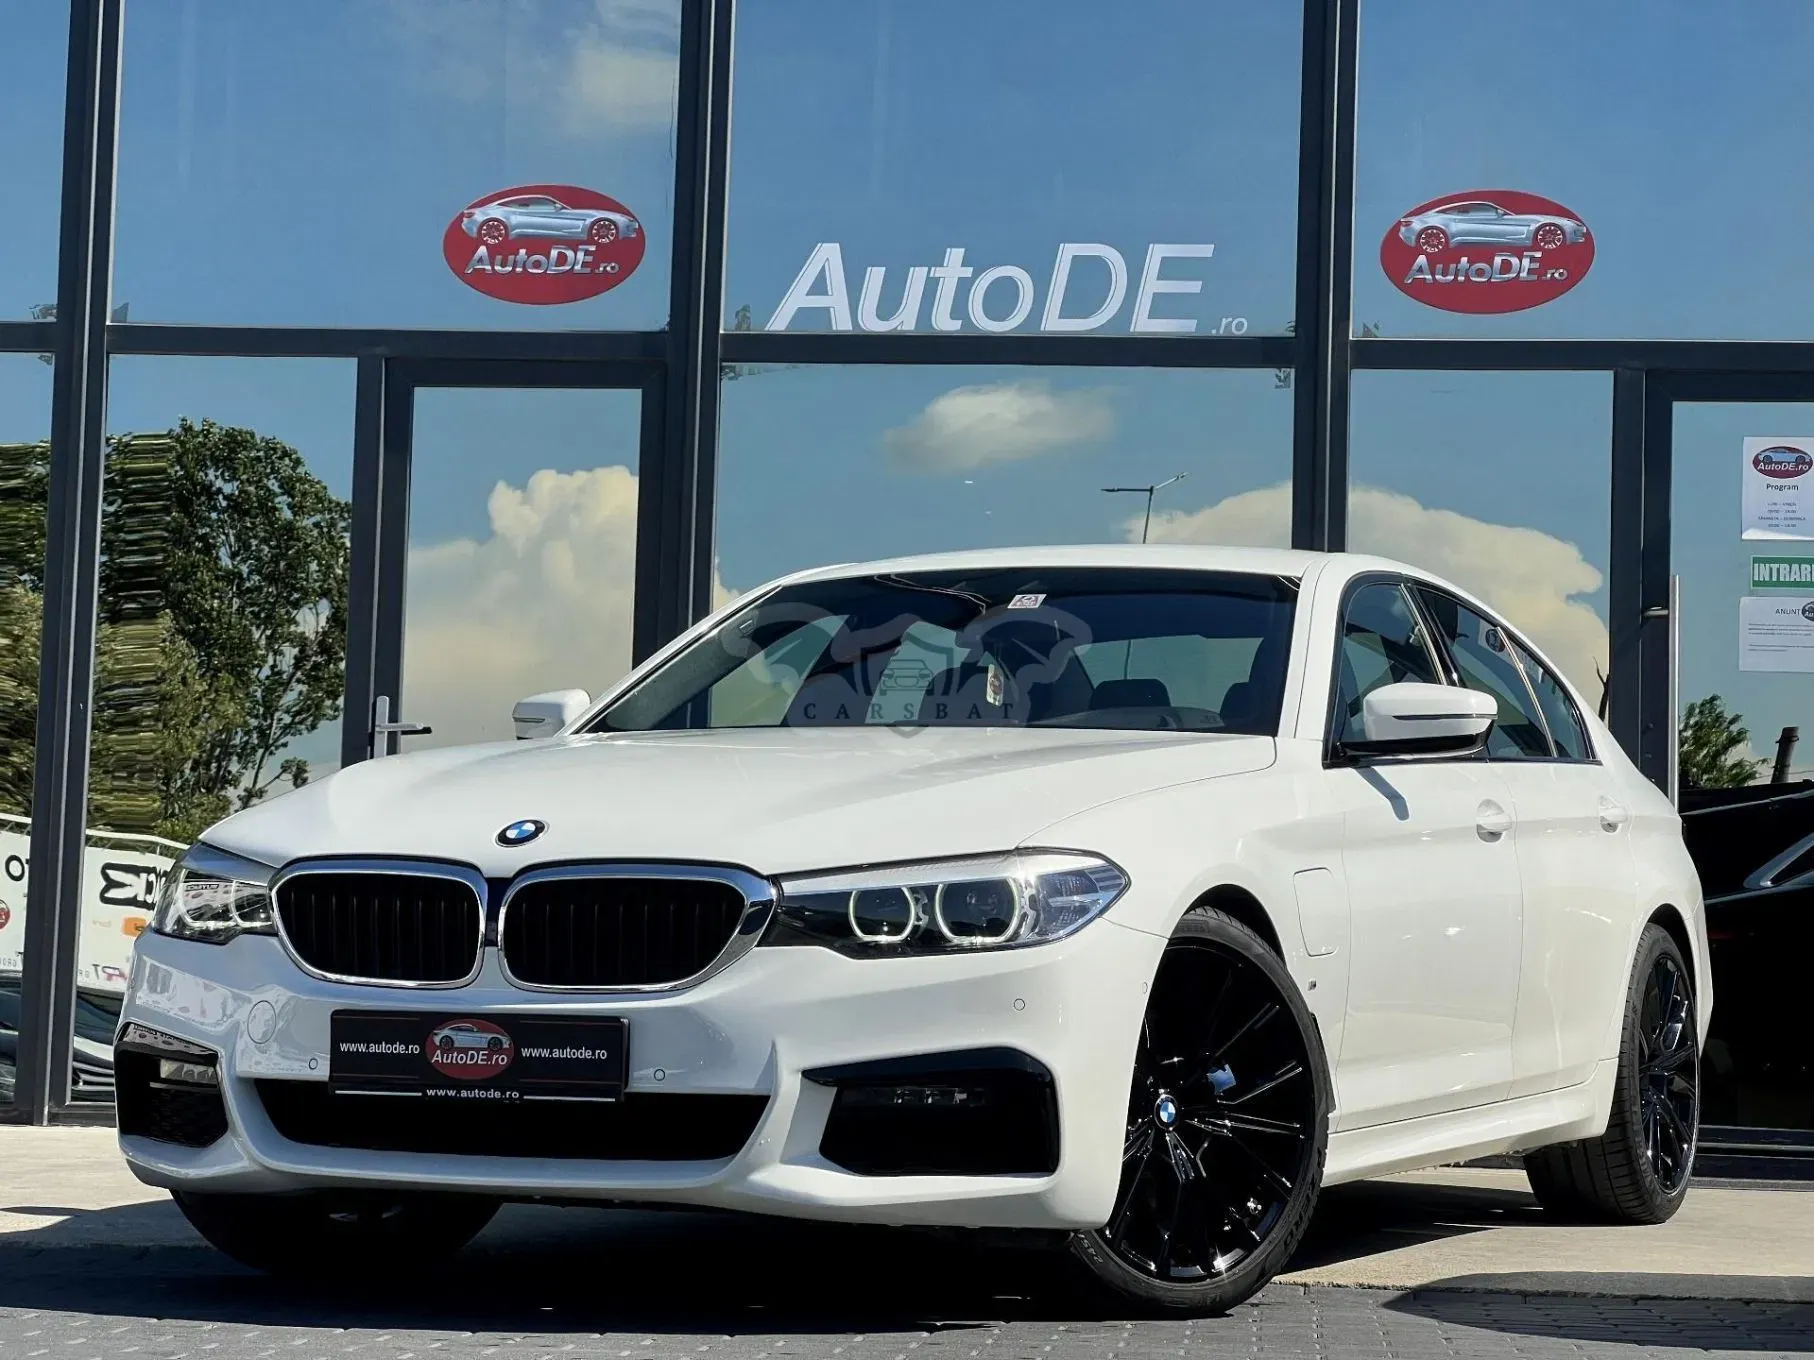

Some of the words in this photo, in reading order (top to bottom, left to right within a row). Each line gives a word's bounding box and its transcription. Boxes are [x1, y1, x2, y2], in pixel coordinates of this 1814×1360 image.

[1757, 462, 1809, 471] AutoDE.ro
[1766, 483, 1799, 491] Program
[1753, 563, 1814, 582] INTRAR
[339, 1040, 420, 1055] www.autode.ro
[521, 1046, 608, 1060] www.autode.ro
[431, 1050, 508, 1066] AutoDE.ro
[426, 1087, 520, 1099] www.autode.ro
